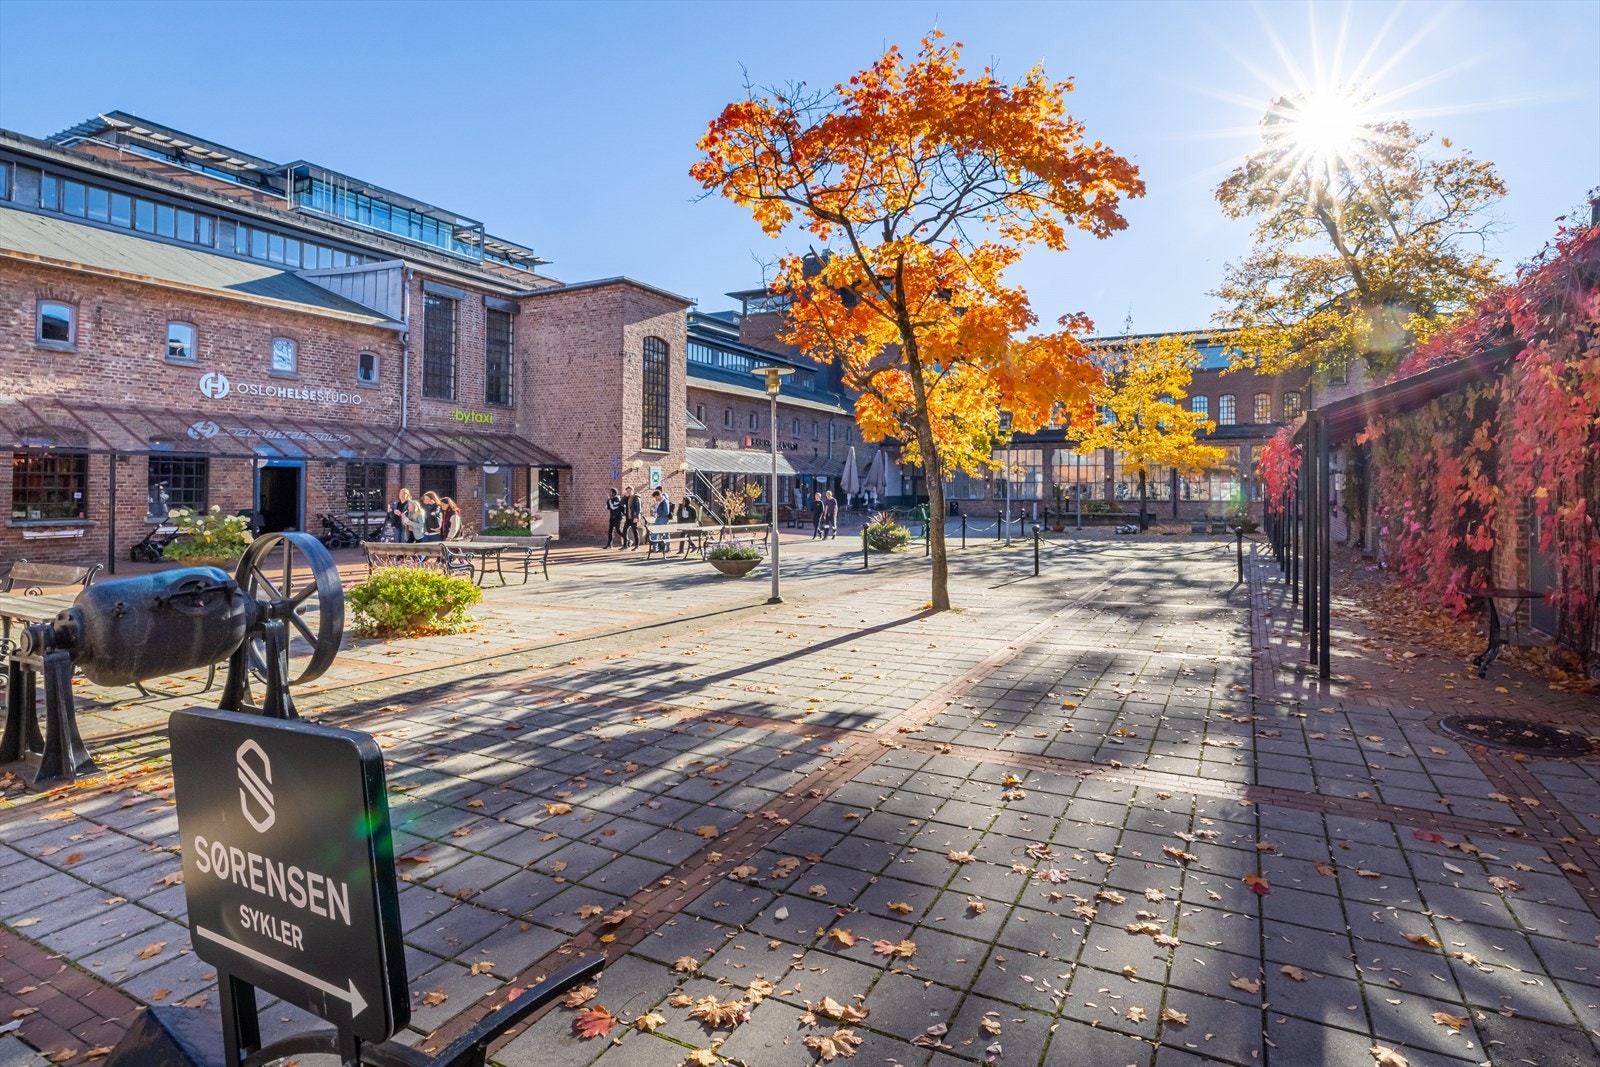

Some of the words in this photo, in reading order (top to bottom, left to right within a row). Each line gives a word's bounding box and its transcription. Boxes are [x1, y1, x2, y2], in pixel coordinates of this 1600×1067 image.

[237, 383, 362, 405] OSLOHELSESTUDIO
[194, 835, 352, 926] SØRENSEN
[239, 904, 305, 952] SYKLER
